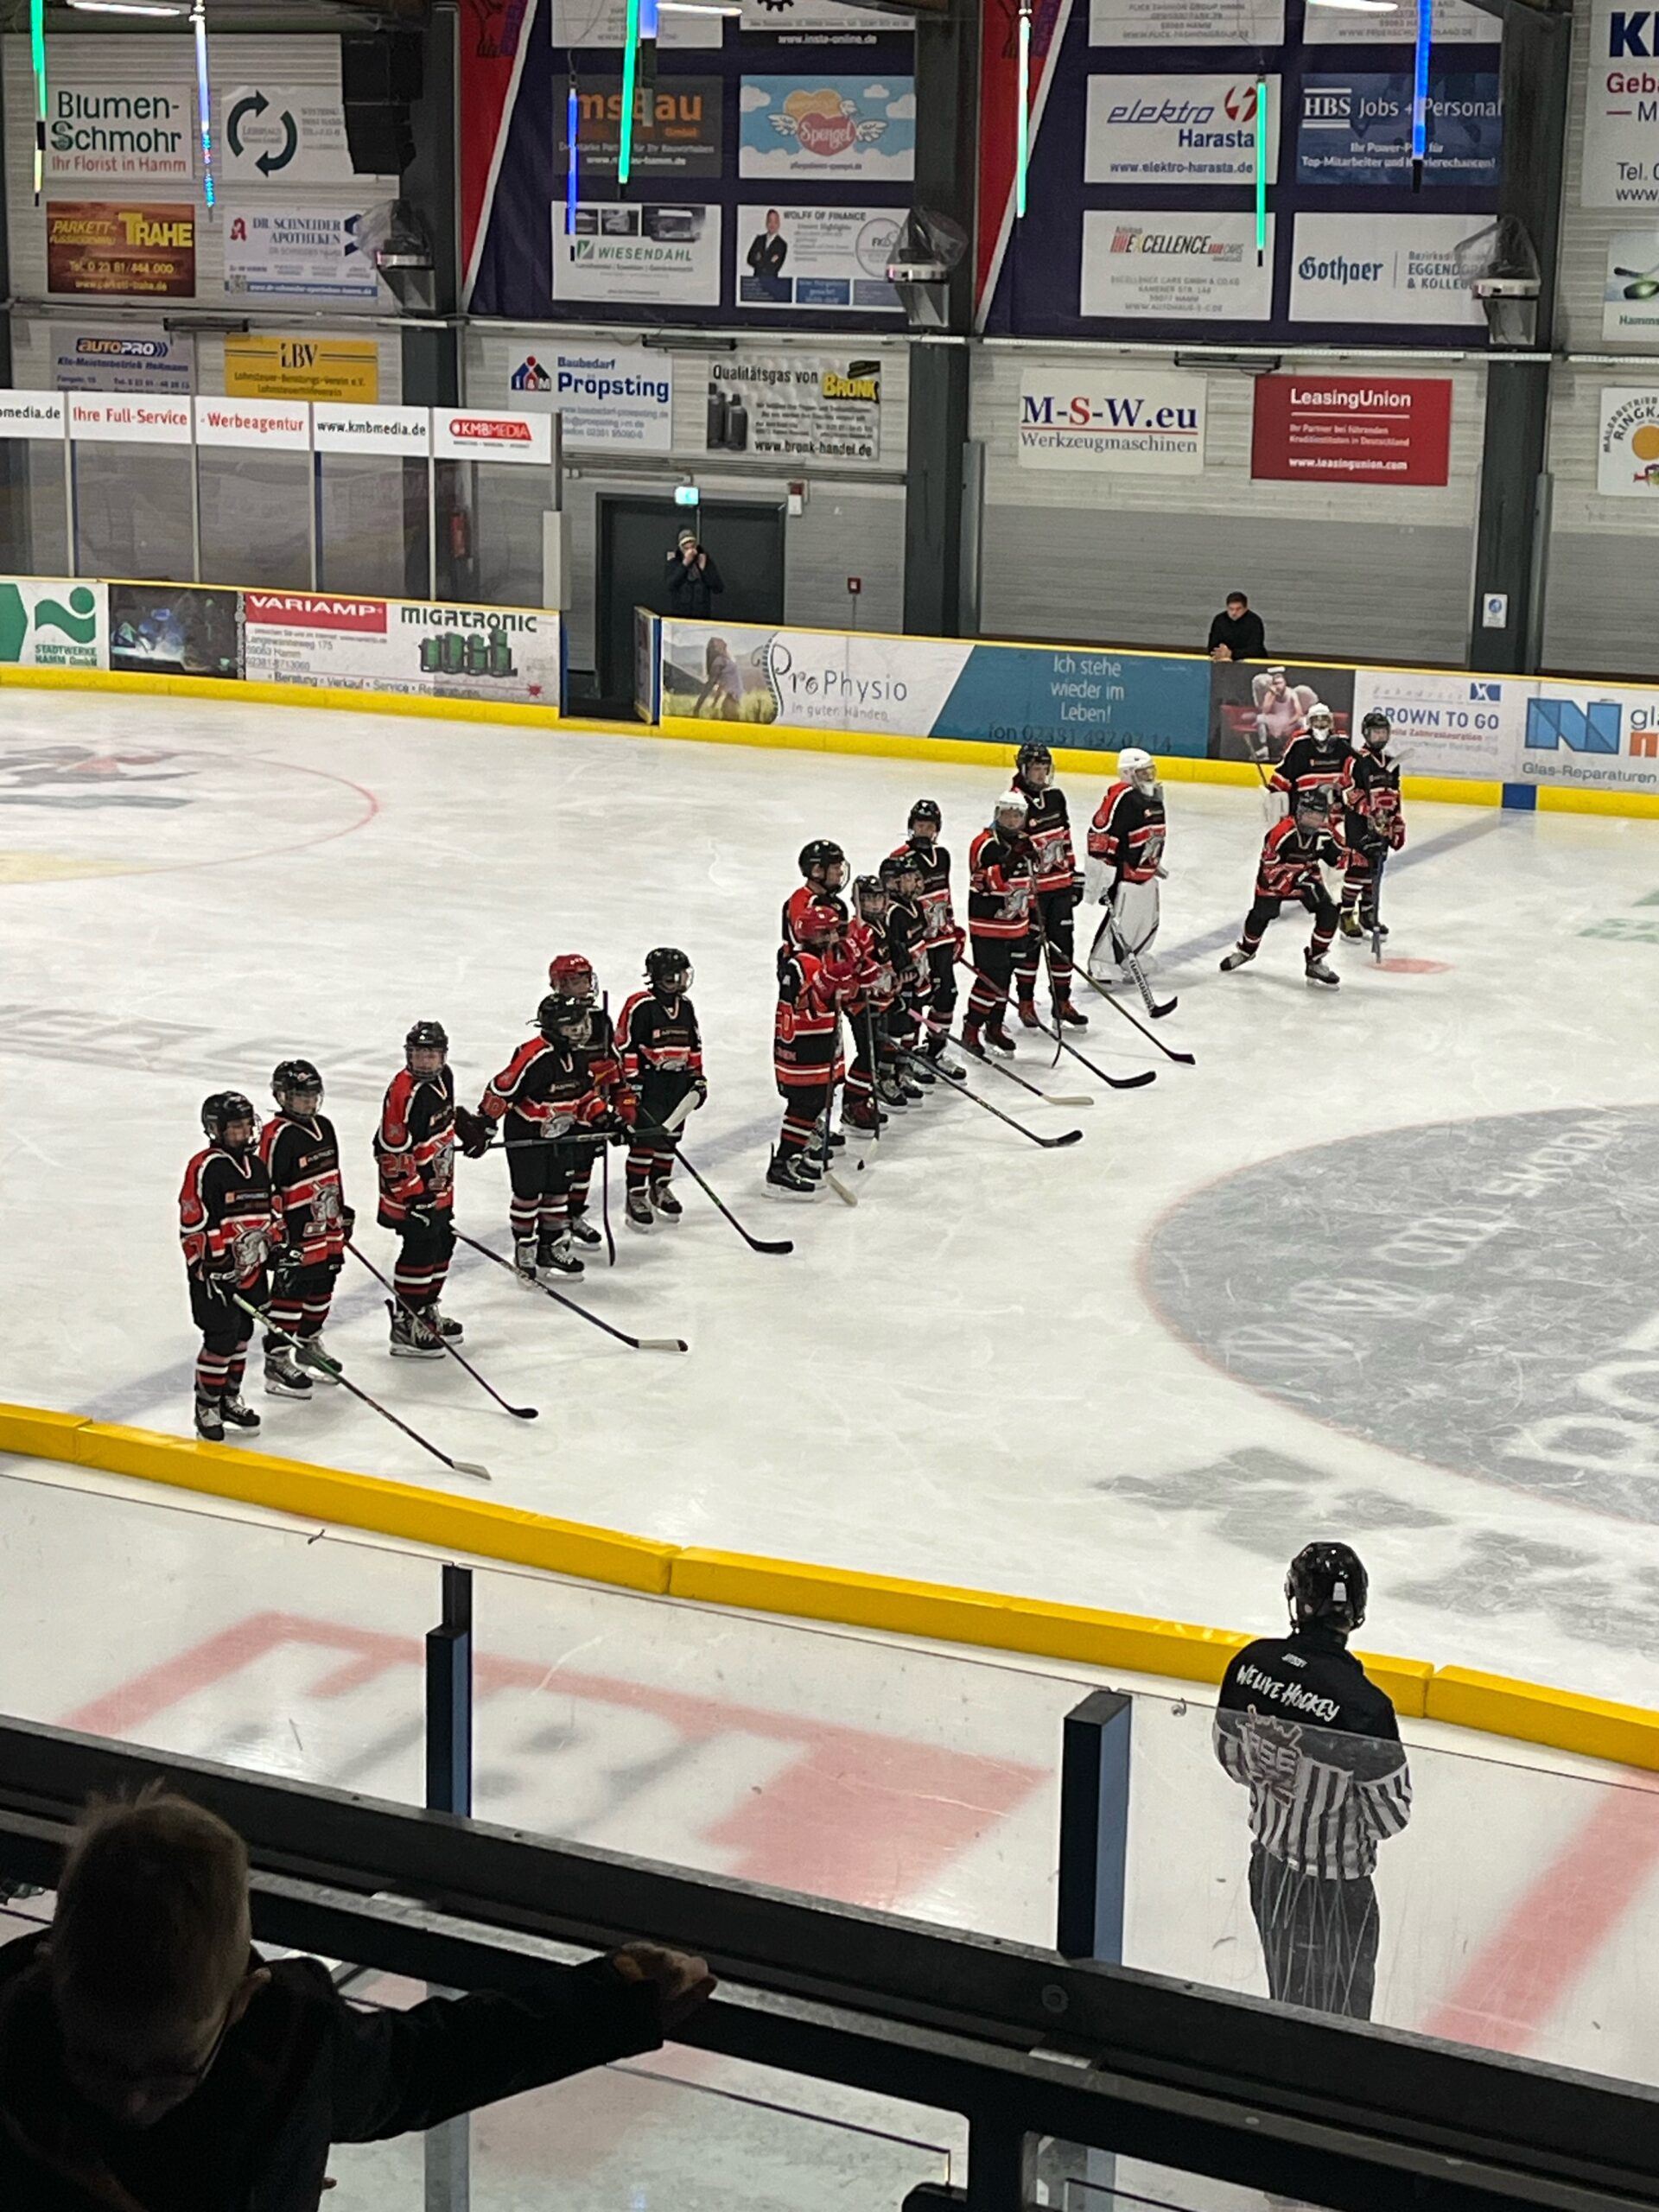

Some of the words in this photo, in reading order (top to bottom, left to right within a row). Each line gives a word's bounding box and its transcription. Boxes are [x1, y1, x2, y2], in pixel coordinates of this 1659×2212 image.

[1609, 11, 1659, 57] K
[1606, 72, 1659, 94] Geb
[58, 91, 180, 118] Blumen-
[1107, 99, 1216, 124] elektro
[1304, 97, 1351, 117] HBS
[1358, 98, 1399, 119] Jobs
[50, 120, 181, 153] Schmohr
[800, 121, 853, 149] Spengel
[1179, 129, 1255, 148] Harasta
[52, 156, 71, 171] Ihr
[74, 156, 118, 172] Florist
[122, 156, 135, 172] in
[139, 156, 187, 172] Hamm
[1109, 162, 1253, 173] www.elektro-harasta.de
[1301, 156, 1382, 168] Top-Mitarbeiter
[1617, 162, 1649, 181] Tel.
[1616, 188, 1659, 200] www
[274, 218, 340, 232] SCHNEIDER
[784, 211, 812, 220] WOLFF
[815, 212, 825, 220] OF
[829, 212, 867, 222] FINANCE
[53, 220, 118, 234] PARKETT-
[118, 212, 193, 247] TRAHE
[270, 232, 340, 245] APOTHEKEN
[598, 247, 693, 262] WIESENDAHL
[1126, 234, 1211, 255] EXCELLENCE
[1298, 255, 1385, 286] Gothaer
[557, 356, 616, 370] Baubedarf
[557, 372, 670, 404] Pröpsting
[713, 364, 791, 385] Qualitätsgas
[795, 371, 818, 384] von
[823, 372, 878, 401] BRONK
[1290, 388, 1412, 410] LeasingUnion
[73, 406, 100, 422] Ihre
[207, 411, 304, 433] Werbeagentur
[1021, 396, 1198, 429] M-S-W.eu
[1613, 406, 1659, 441] RINGK
[317, 421, 427, 436] www.kmbmedia.de
[461, 422, 531, 438] KMBMEDIA
[1302, 423, 1332, 433] Partner
[1334, 424, 1347, 435] bei
[1021, 432, 1198, 454] Werkzeugmaschinen
[1360, 435, 1410, 448] Deutschland
[1288, 457, 1408, 471] www.leasingunion.com
[250, 594, 377, 617] VARIAMP
[401, 607, 538, 633] MIGATRONIC
[35, 644, 97, 657] STADTWERKE
[35, 655, 66, 664] HAMM
[1053, 654, 1076, 675] Ich
[1080, 658, 1122, 677] stehe
[275, 671, 318, 688] Beratung
[327, 677, 365, 690] Verkauf
[372, 681, 410, 694] Service
[752, 642, 907, 716] ProPhysio
[1051, 680, 1103, 699] wieder
[1105, 682, 1124, 700] im
[1061, 702, 1111, 723] Leben!
[1446, 710, 1468, 728] TO
[1475, 713, 1499, 730] GO
[1630, 705, 1659, 731] gl
[1522, 762, 1657, 785] Glas-Reparaturen
[1236, 1664, 1259, 1685] WE
[1252, 1672, 1285, 1700] LIVE
[1281, 1682, 1340, 1722] HOCKEY
